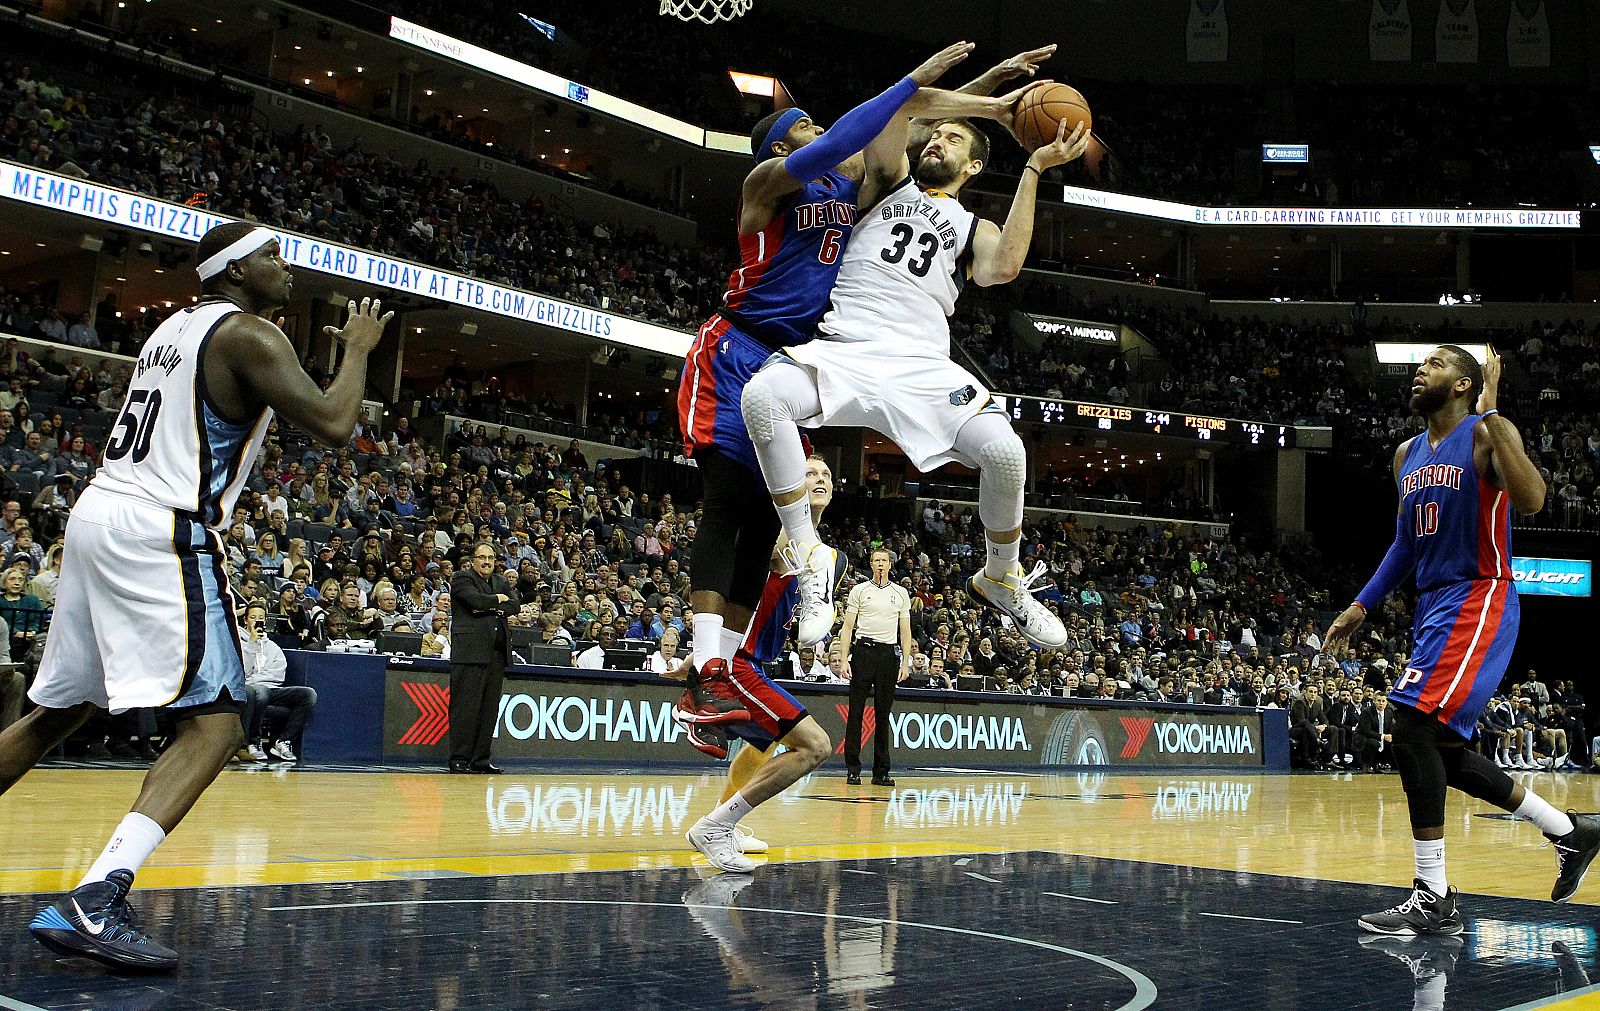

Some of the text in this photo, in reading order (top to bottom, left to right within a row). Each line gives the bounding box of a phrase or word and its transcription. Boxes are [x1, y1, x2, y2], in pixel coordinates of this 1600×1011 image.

[1195, 208, 1208, 222] BE
[1214, 210, 1221, 222] A
[1227, 210, 1325, 223] CARD-CARRYING
[1391, 211, 1412, 224] GET
[1419, 212, 1450, 224] YOUR
[1457, 212, 1513, 225] MEMPHIS
[1519, 213, 1580, 225] GRIZZLIES
[13, 171, 119, 218] MEMPHIS
[310, 244, 357, 274] CARD
[367, 258, 423, 290] TODAY
[429, 275, 449, 297] AT
[456, 281, 612, 336] FTB.COM/GRIZZLIES
[818, 228, 843, 265] 6
[880, 222, 940, 278] 33
[1073, 326, 1117, 342] MINOLTA
[105, 387, 163, 464] 50
[1013, 407, 1022, 419] 5
[1043, 411, 1051, 423] 2
[1153, 424, 1161, 434] 4
[1251, 433, 1259, 444] 2
[1278, 435, 1286, 447] 4
[1077, 404, 1132, 421] GRIZZLIES
[1145, 411, 1170, 425] 2:44
[1185, 416, 1227, 431] PISTONS
[1401, 463, 1464, 501] DETROIT
[1213, 527, 1226, 536] 103
[1415, 501, 1439, 538] 10
[889, 711, 1028, 751] YOKOHAMA
[1153, 721, 1254, 754] YOKOHAMA
